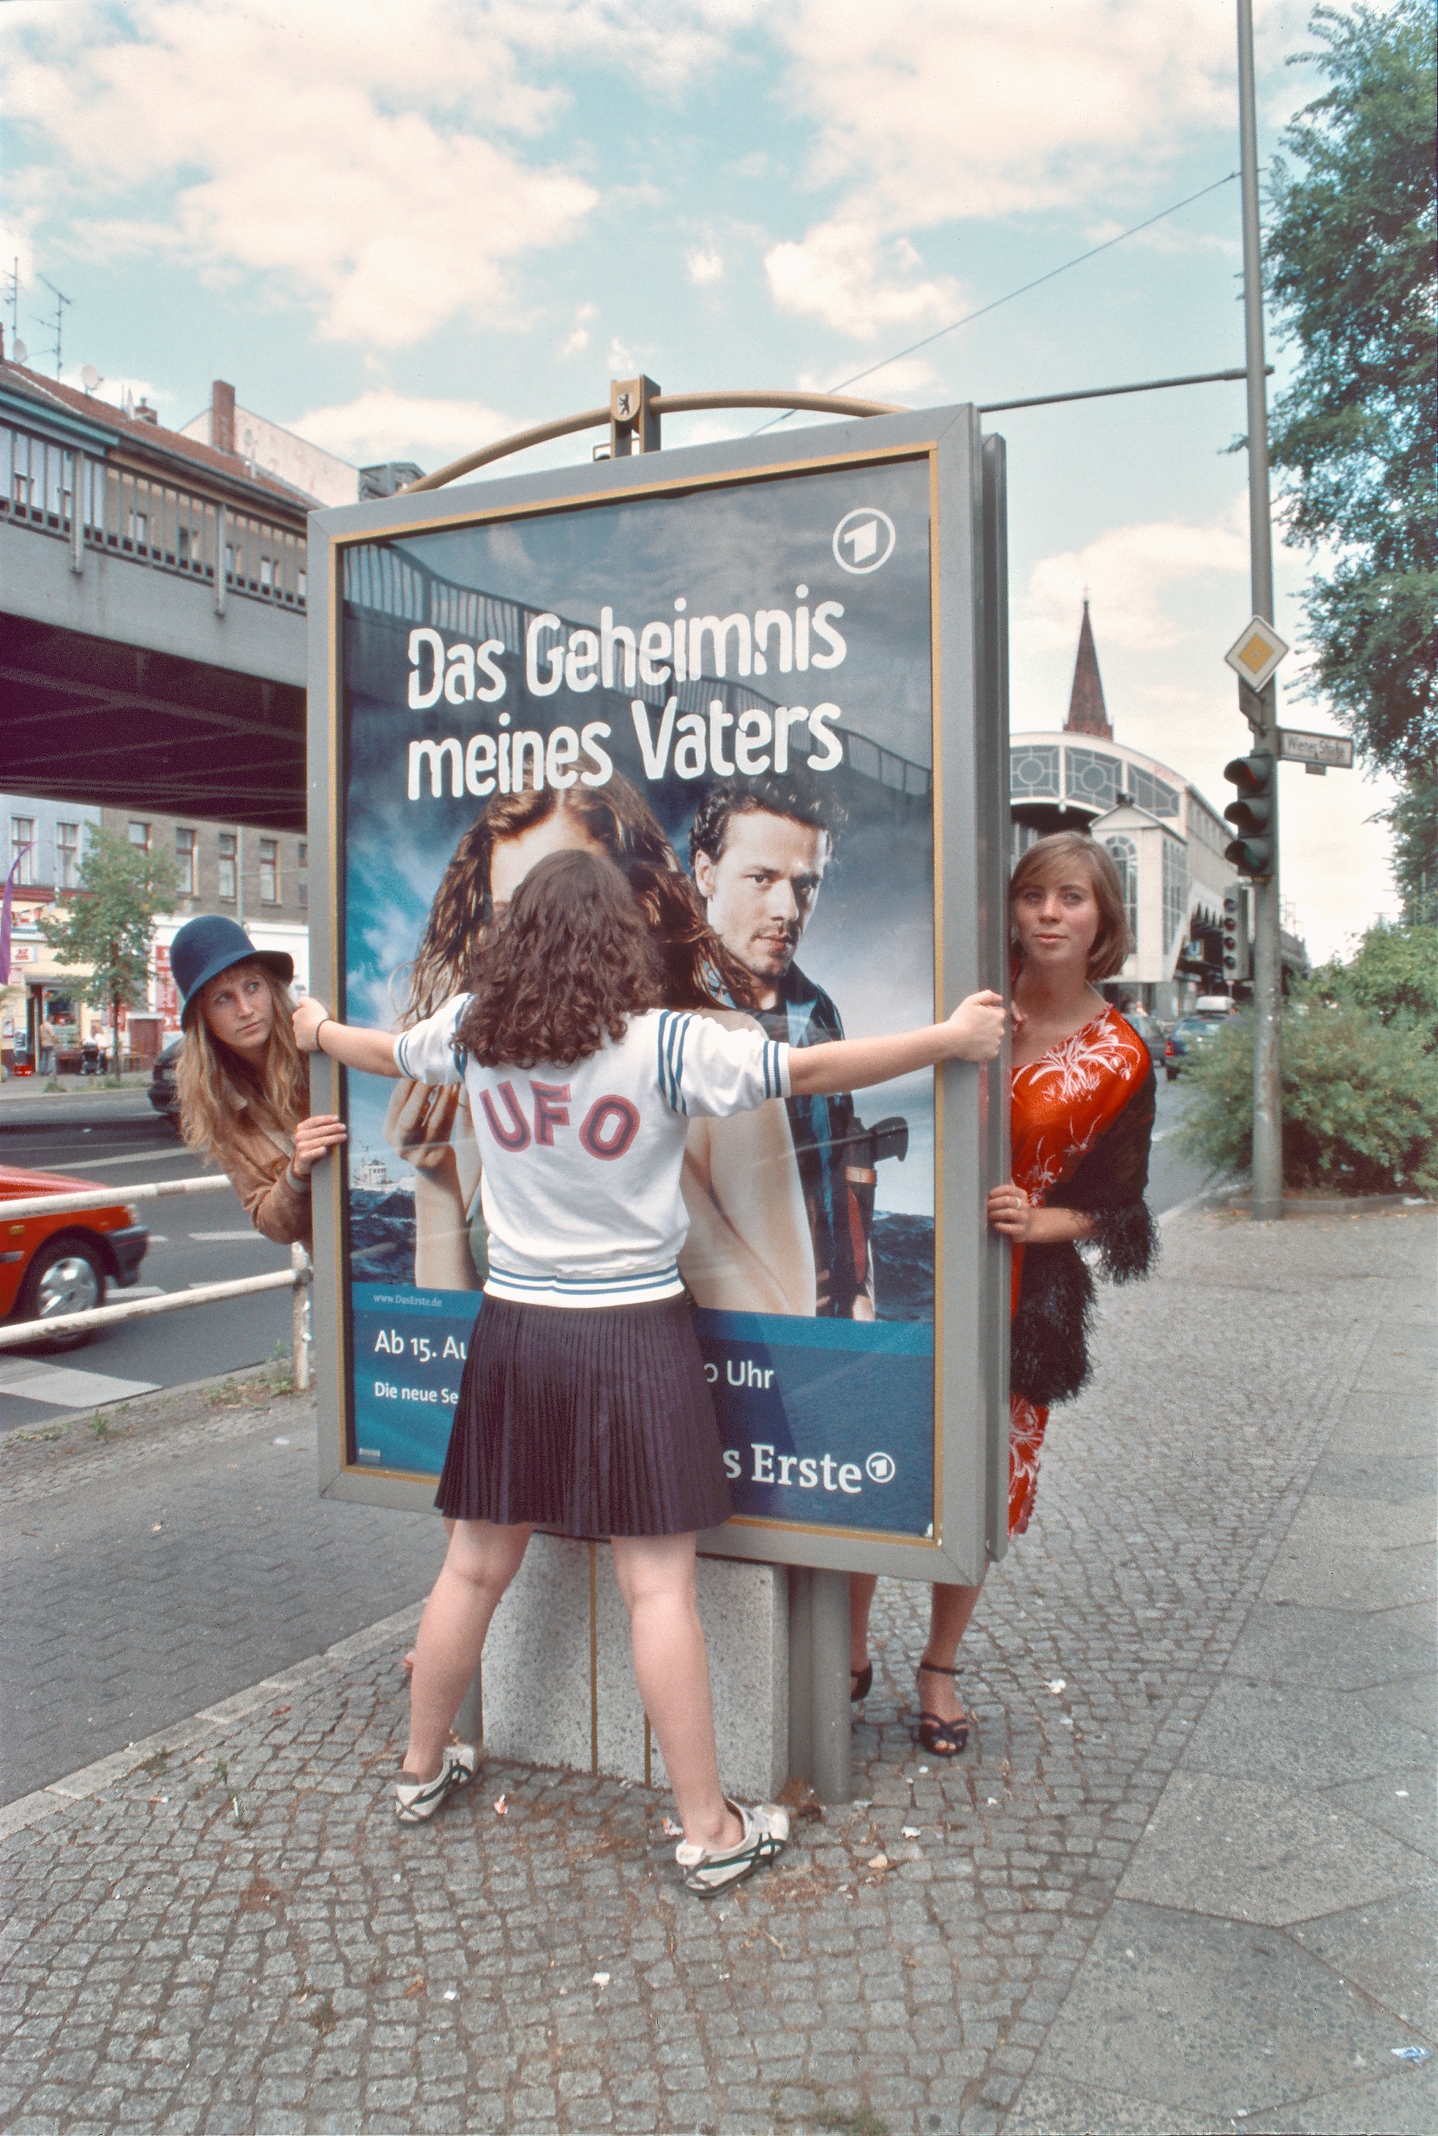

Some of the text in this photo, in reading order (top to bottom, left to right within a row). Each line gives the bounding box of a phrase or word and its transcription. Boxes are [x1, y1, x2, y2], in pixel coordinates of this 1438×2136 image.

[408, 584, 848, 710] Das Geheimnis
[408, 696, 844, 800] meines Vaters
[1288, 736, 1317, 752] Wiener
[479, 1079, 641, 1161] UFO
[373, 1293, 442, 1308] www.DasErste.de
[374, 1329, 404, 1355] Ab
[410, 1336, 437, 1362] 15.
[726, 1359, 774, 1389] Uhr
[374, 1381, 397, 1399] Die
[401, 1388, 437, 1402] neue
[751, 1443, 863, 1494] Erste
